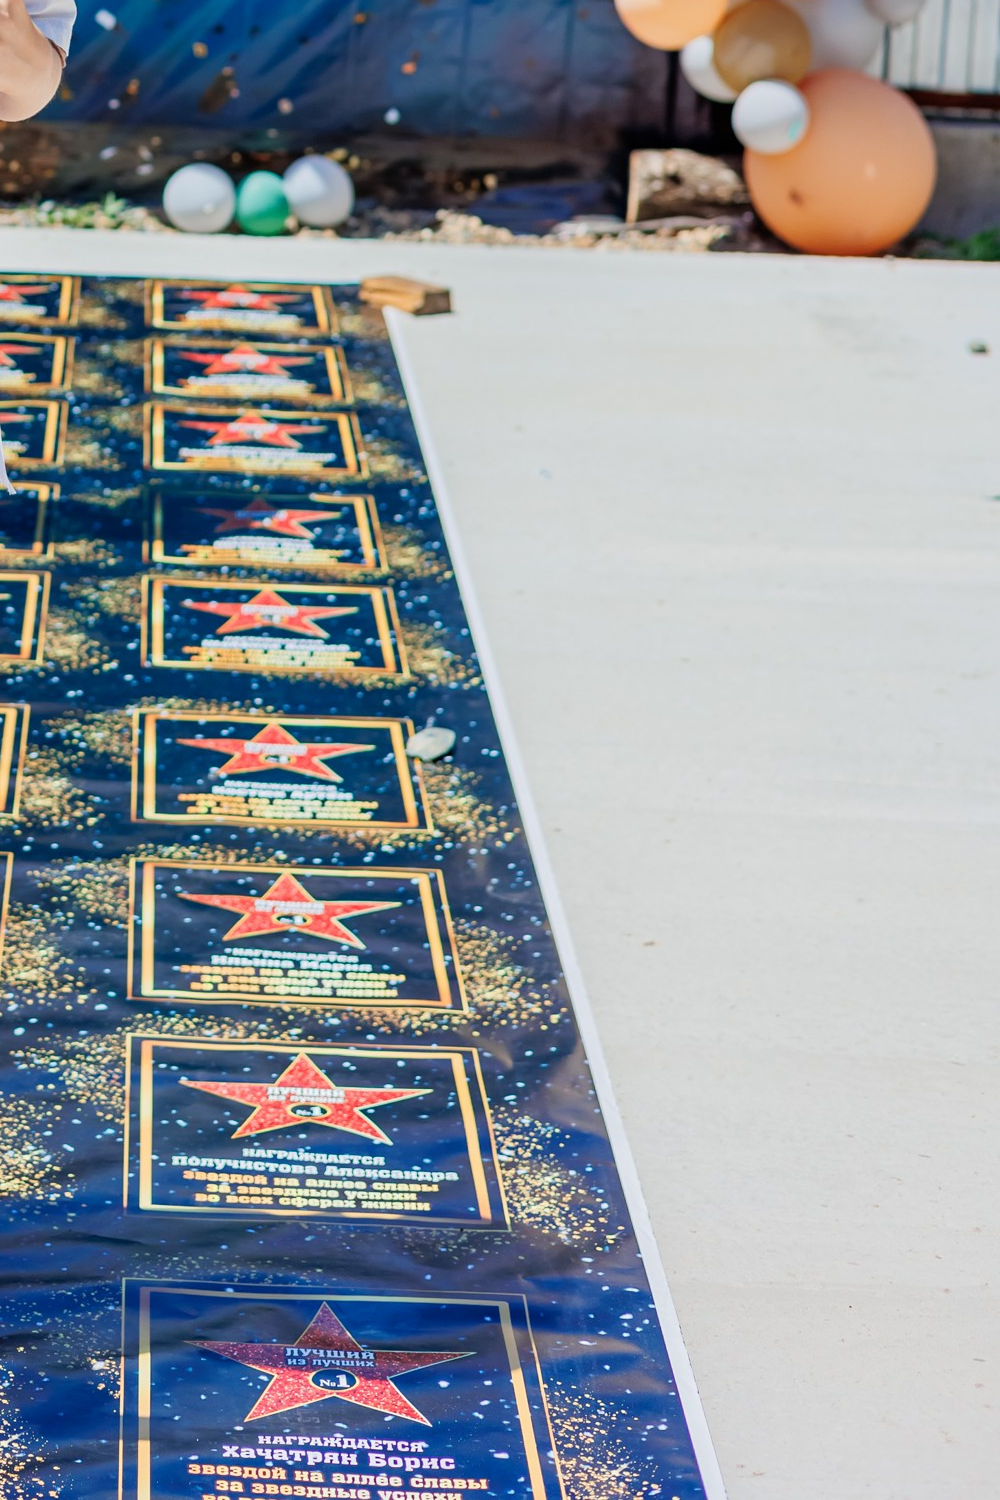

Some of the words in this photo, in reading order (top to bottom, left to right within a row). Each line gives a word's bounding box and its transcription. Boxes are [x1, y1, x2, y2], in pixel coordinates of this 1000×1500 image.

[242, 1147, 386, 1166] НАГРАЖДАЕТСЯ
[171, 1155, 319, 1177] Получистова
[324, 1164, 460, 1183] Александра
[182, 1169, 268, 1185] звездой
[273, 1176, 300, 1187] на
[305, 1178, 367, 1190] аллее
[372, 1180, 440, 1193] славы
[195, 1192, 220, 1203] во
[225, 1194, 274, 1206] всех
[279, 1194, 357, 1211] сферах
[361, 1198, 431, 1212] жизни
[206, 1182, 231, 1194] за
[236, 1184, 339, 1198] звездные
[344, 1188, 418, 1202] успехи
[285, 1346, 376, 1361] ЛУЧШИЙ
[287, 1357, 308, 1368] из
[311, 1358, 376, 1368] лучших
[318, 1373, 351, 1390] №1
[258, 1434, 425, 1453] НАГРАЖДАЕТСЯ
[222, 1445, 359, 1467] Хачатрян
[367, 1452, 456, 1472] Борис
[188, 1463, 287, 1481] звездой
[294, 1470, 325, 1484] на
[332, 1472, 403, 1488] аллее
[410, 1476, 490, 1491] славы
[215, 1479, 245, 1493] за
[251, 1483, 371, 1500] звездные
